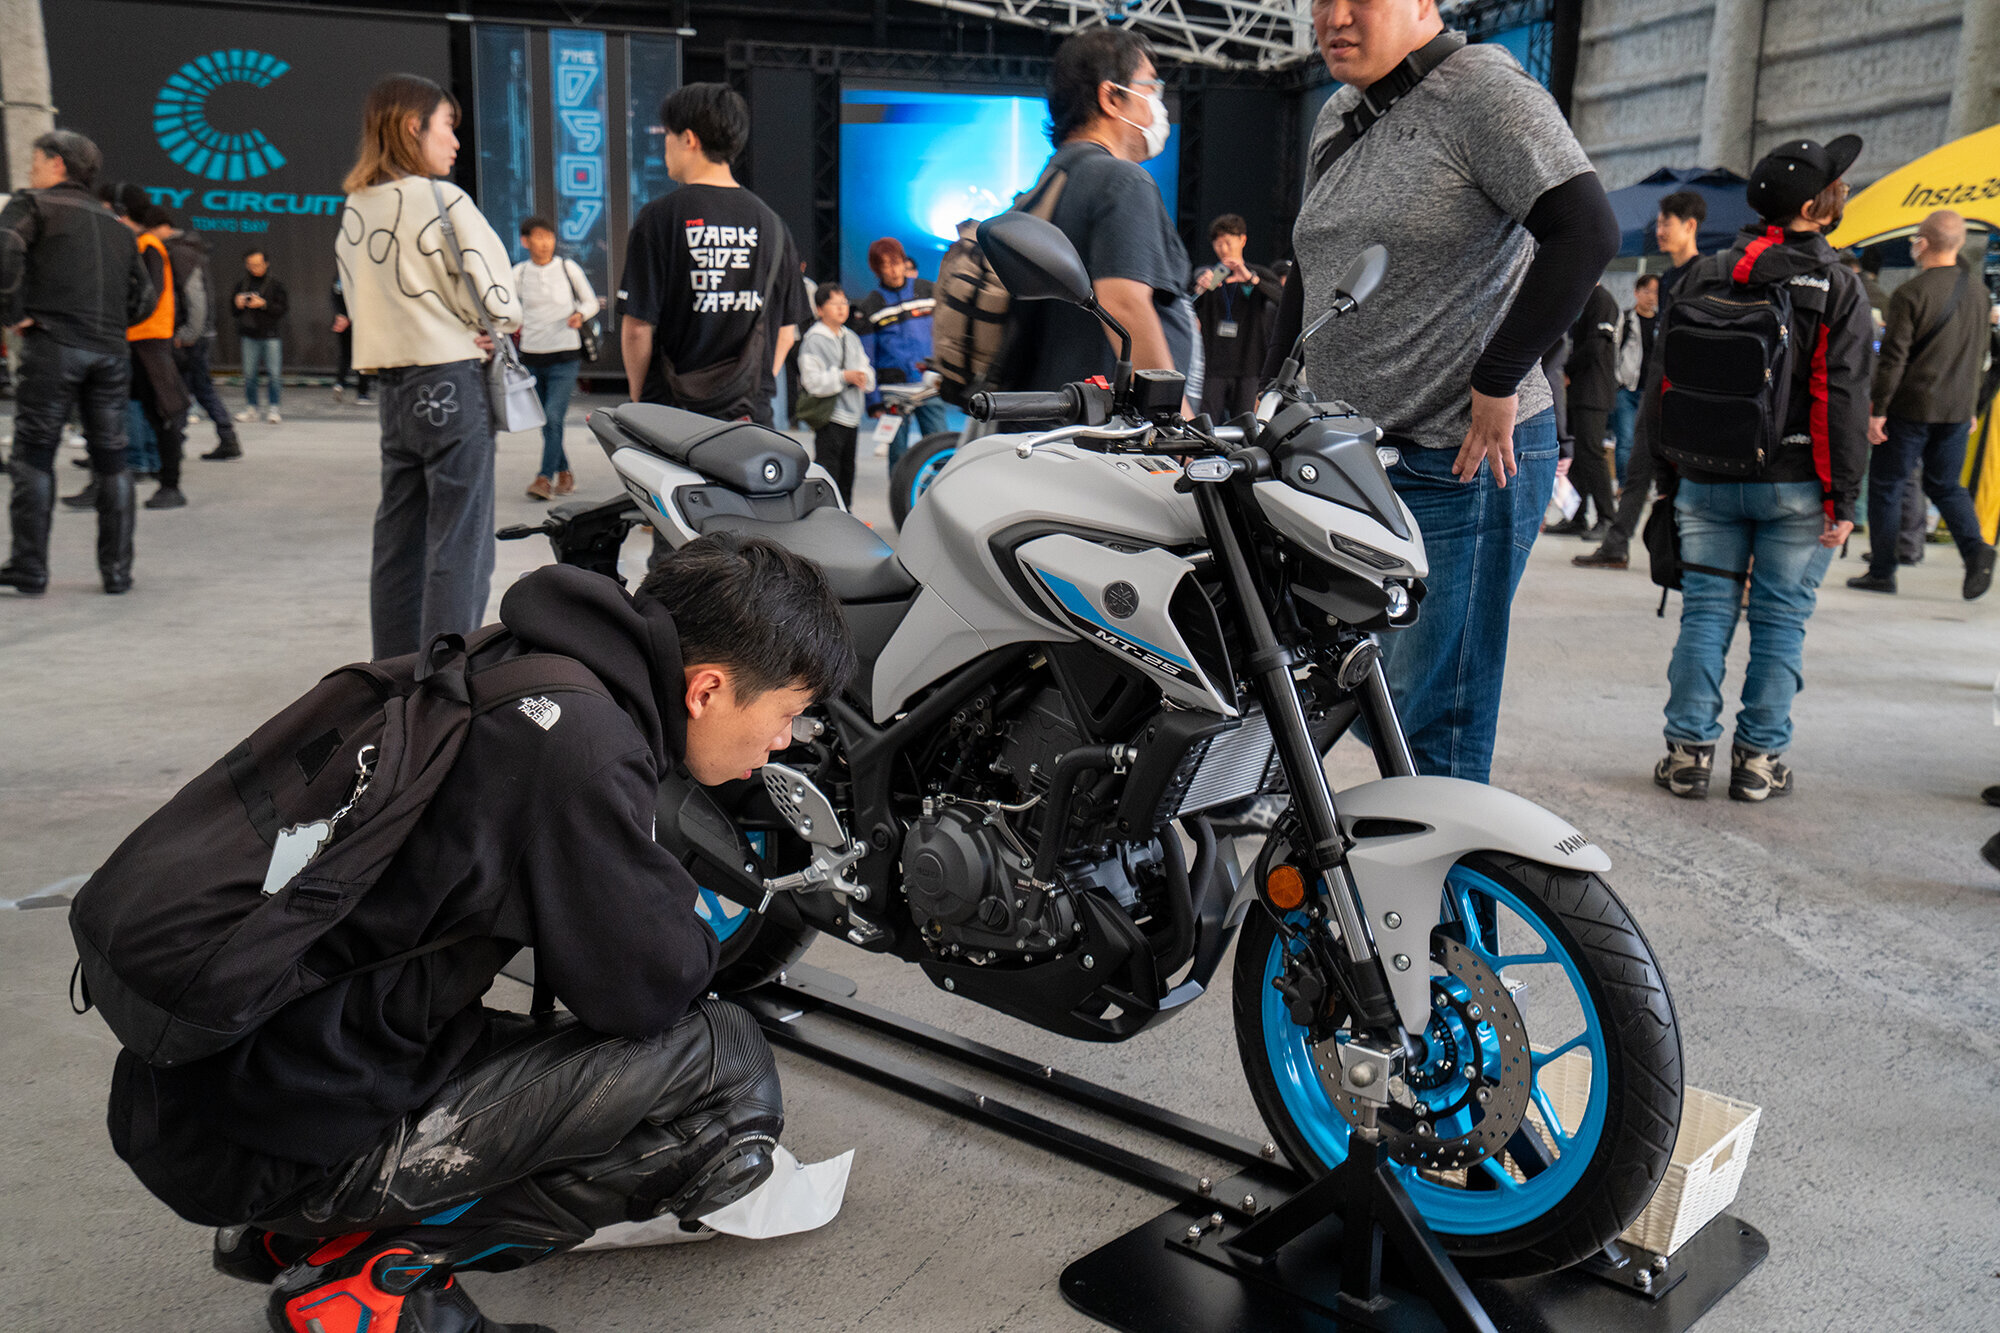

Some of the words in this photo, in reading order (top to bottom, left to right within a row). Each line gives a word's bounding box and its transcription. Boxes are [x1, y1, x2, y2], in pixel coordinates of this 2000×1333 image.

[202, 190, 345, 216] CIRCUIT
[192, 216, 237, 232] TOKYO
[240, 218, 269, 233] BAY
[686, 226, 758, 247] DARK
[690, 270, 726, 290] OF
[693, 290, 763, 313] JAPAN
[1095, 630, 1181, 675] MT-25
[538, 696, 555, 709] THE
[517, 704, 544, 722] FACE
